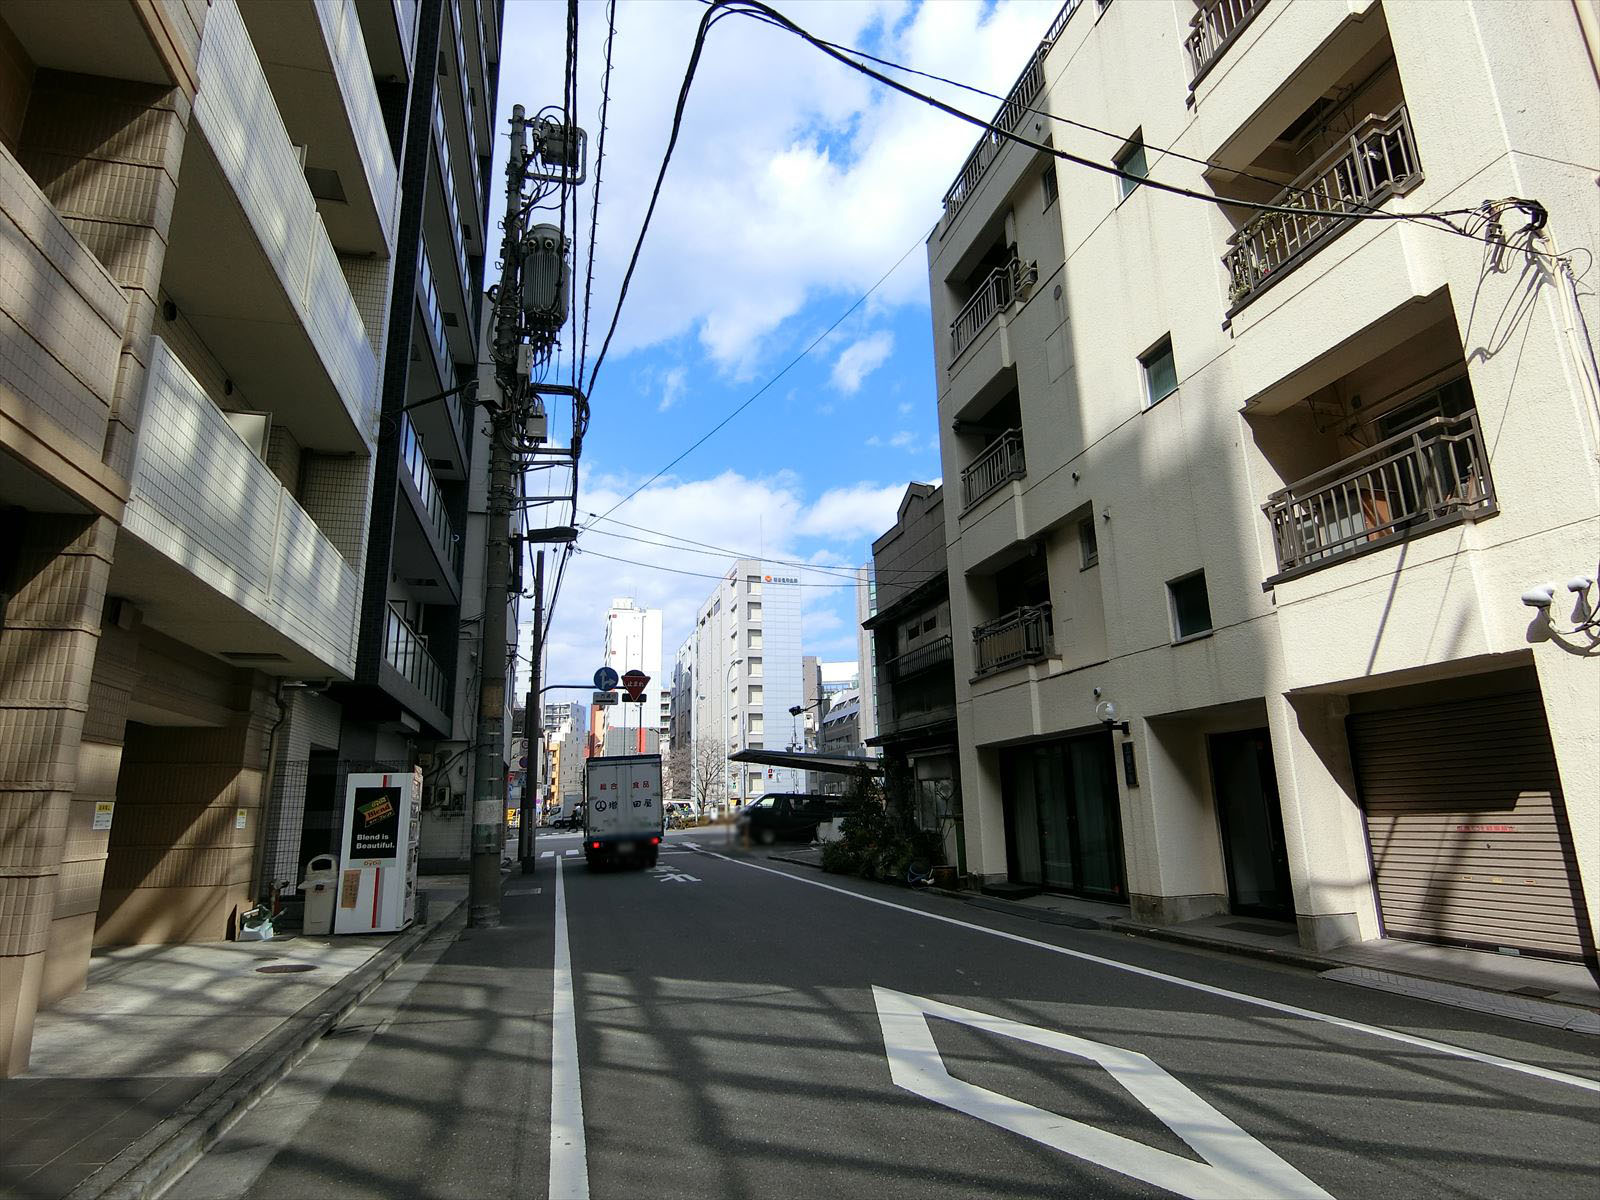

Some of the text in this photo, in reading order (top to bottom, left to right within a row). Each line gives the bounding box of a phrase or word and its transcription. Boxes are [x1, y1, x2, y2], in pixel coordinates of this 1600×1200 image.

[367, 804, 390, 818] Blend
[356, 833, 380, 841] Blend
[356, 841, 395, 849] Beautiful.
